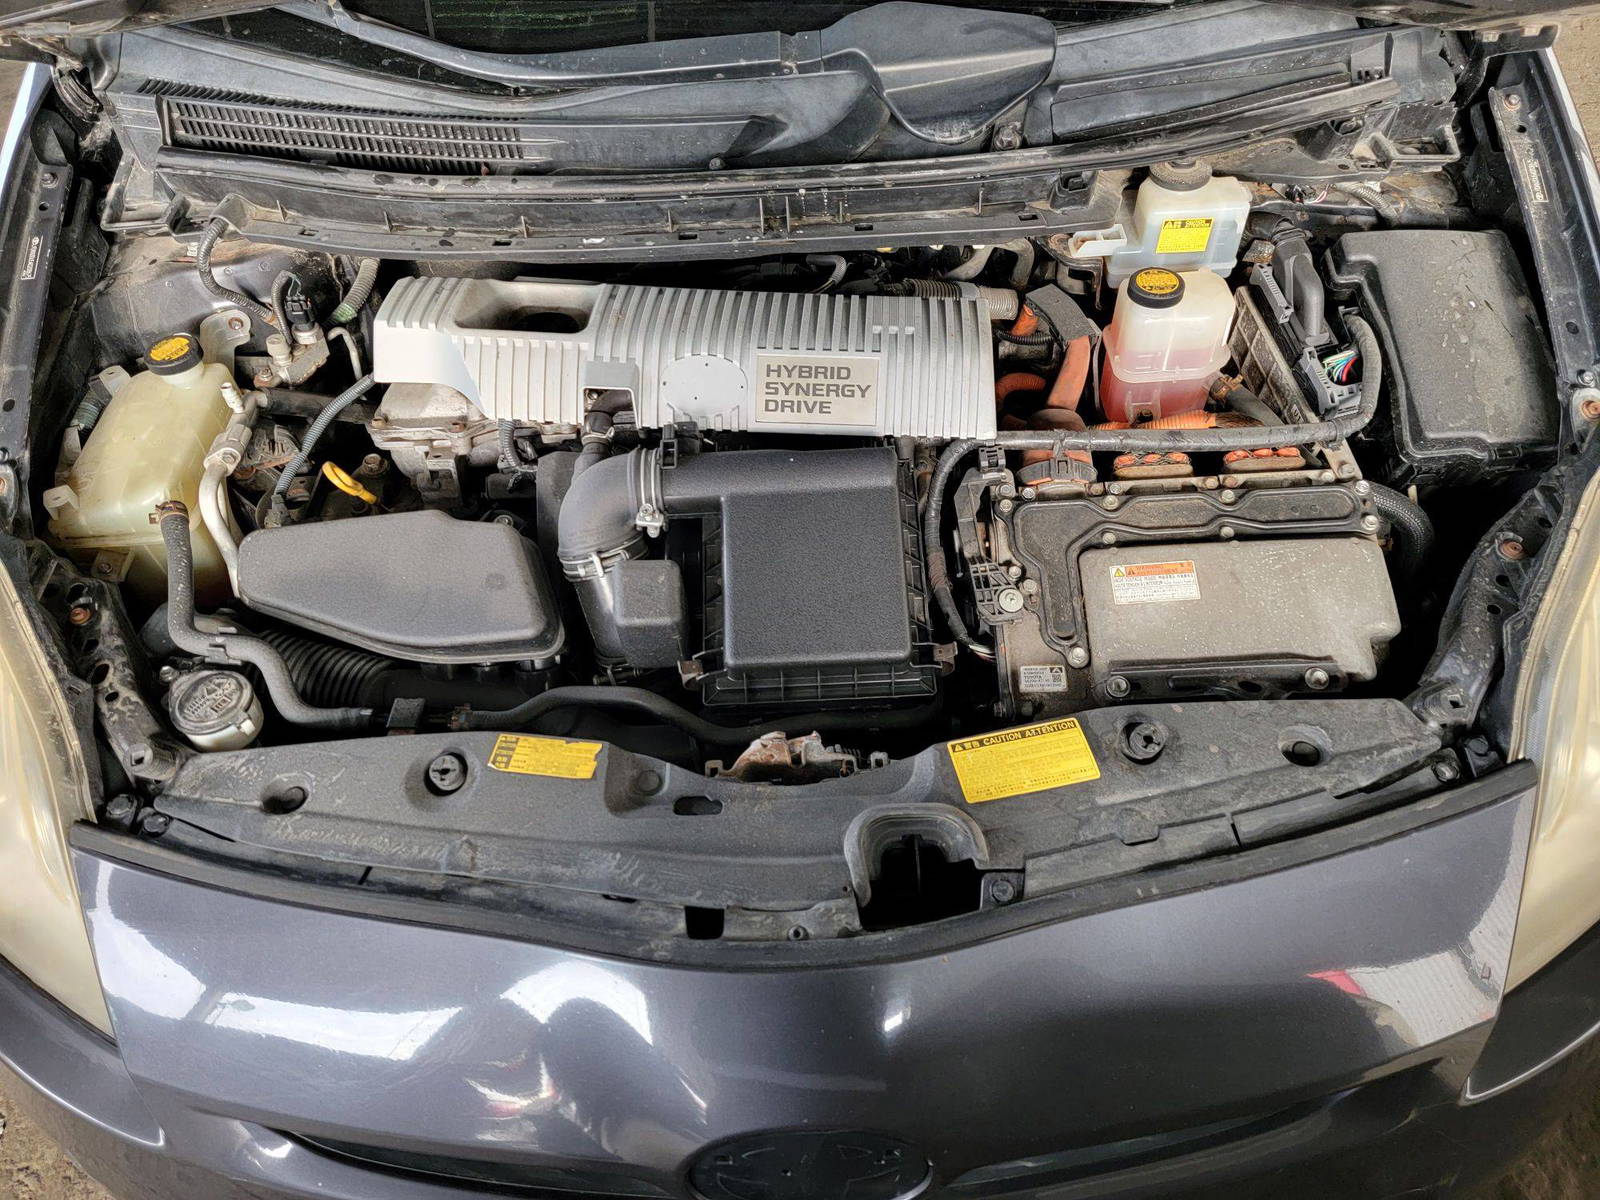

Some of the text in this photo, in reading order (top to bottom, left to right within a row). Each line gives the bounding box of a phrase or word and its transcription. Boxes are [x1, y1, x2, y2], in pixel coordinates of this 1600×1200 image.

[766, 364, 851, 380] HYBRID
[765, 382, 871, 398] SYNERGY
[764, 399, 832, 414] DRIVE
[983, 732, 1022, 746] CAUTION
[1025, 721, 1075, 737] ATTENTION
